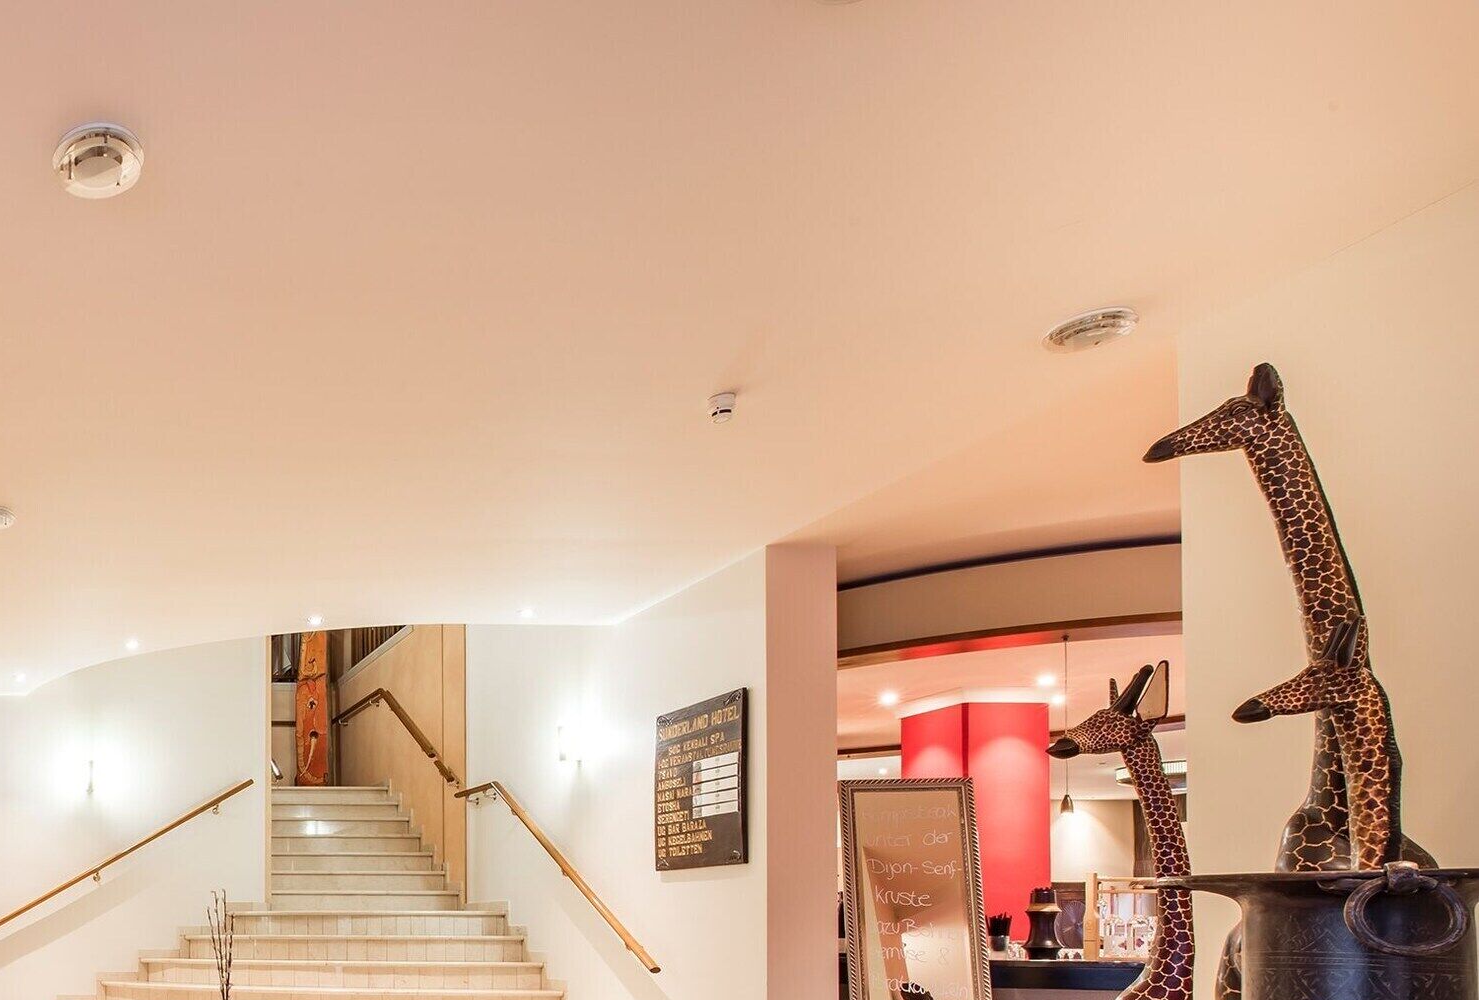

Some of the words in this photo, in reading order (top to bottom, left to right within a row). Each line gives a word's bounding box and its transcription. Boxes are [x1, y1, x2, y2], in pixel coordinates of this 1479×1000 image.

[659, 714, 709, 740] SUNDERLAND
[711, 705, 740, 727] HOTEL
[709, 731, 725, 745] SPA
[657, 800, 681, 814] ETOSHA
[657, 825, 667, 837] UG
[668, 823, 681, 835] BAR
[682, 819, 707, 833] BARAZA
[657, 837, 667, 848] UG
[668, 830, 713, 846] KEGELBAHNEN
[923, 829, 953, 846] der
[668, 843, 703, 857] TOILETTEN
